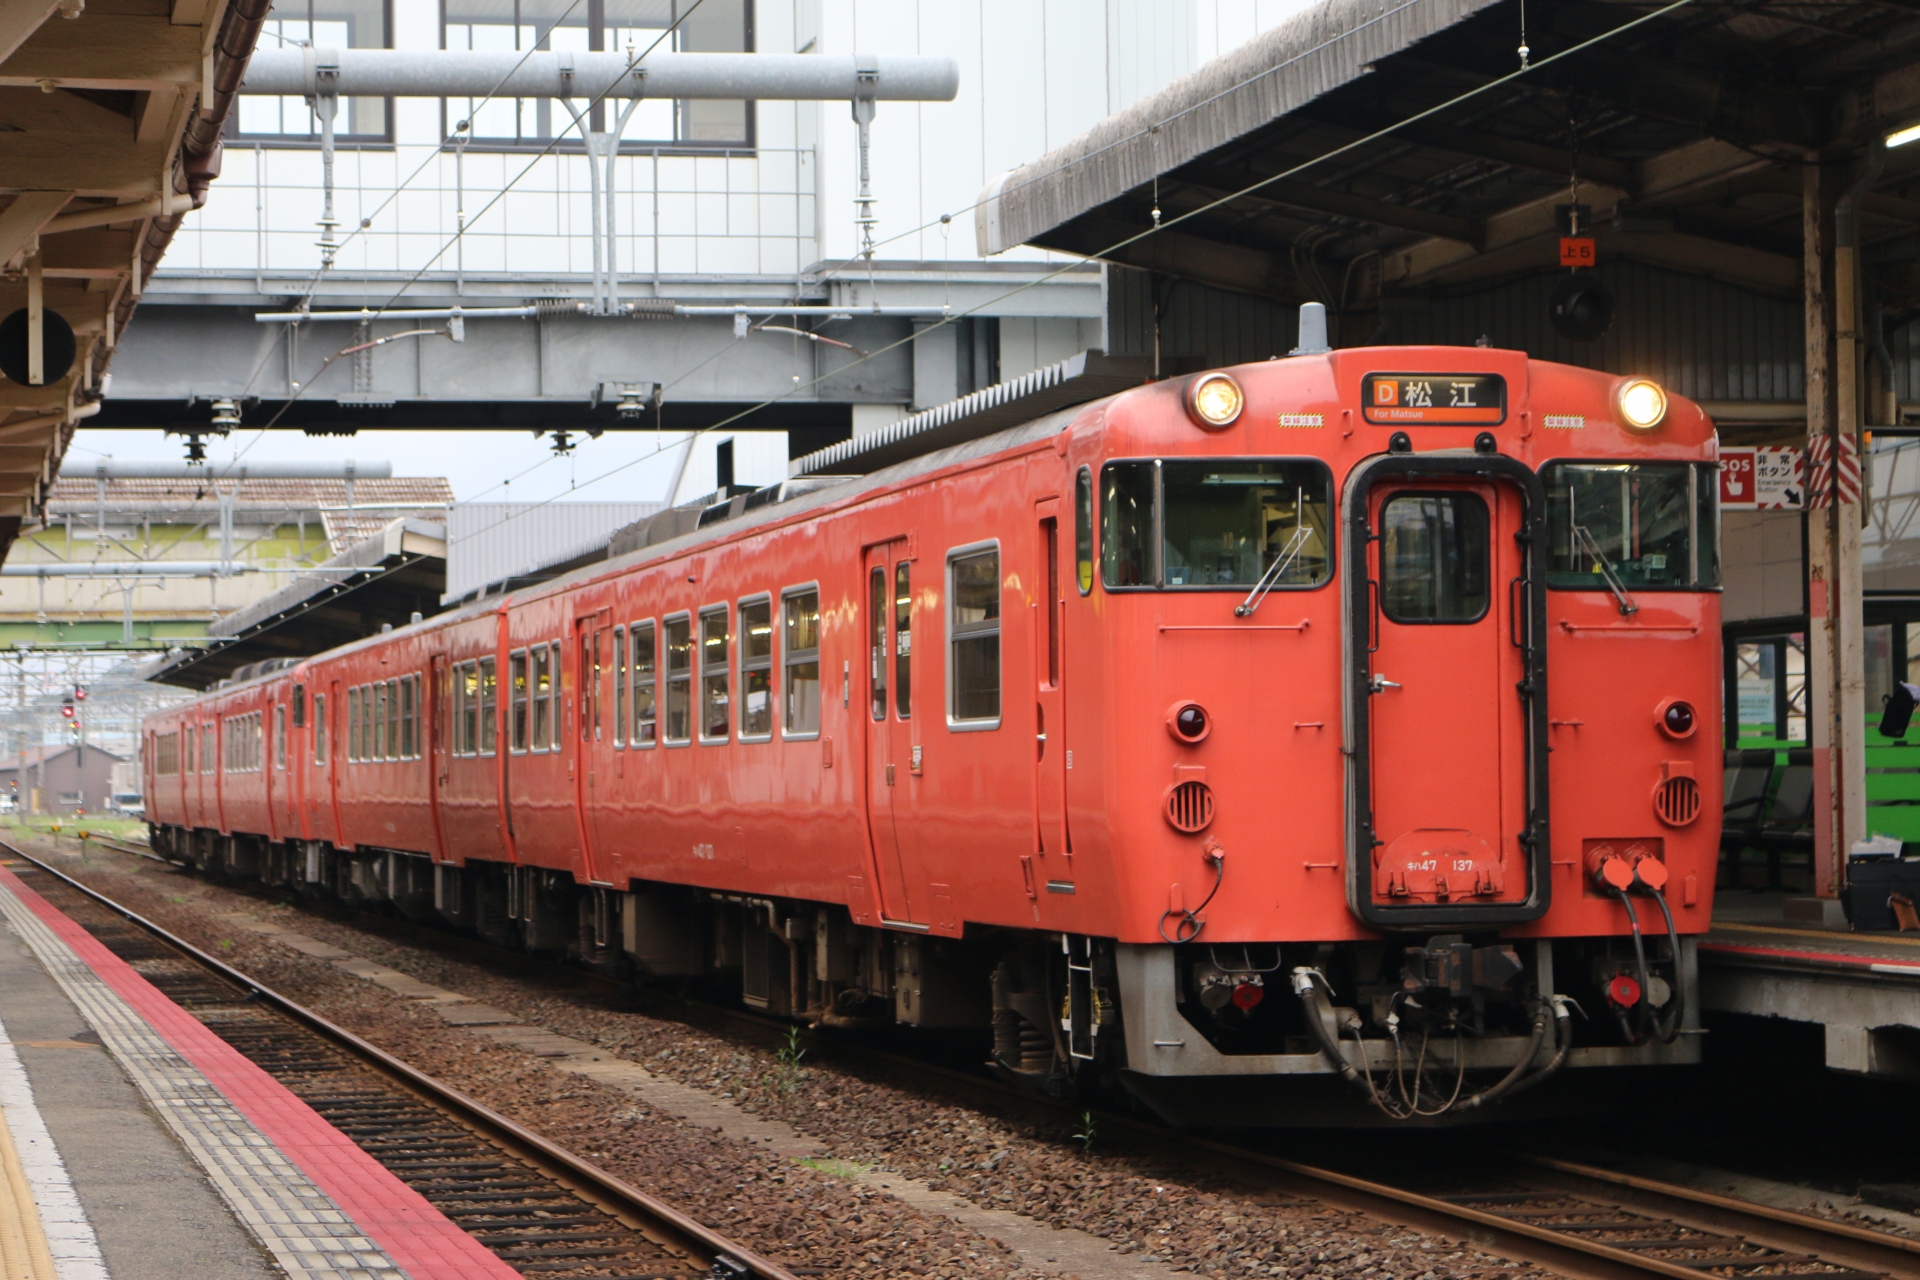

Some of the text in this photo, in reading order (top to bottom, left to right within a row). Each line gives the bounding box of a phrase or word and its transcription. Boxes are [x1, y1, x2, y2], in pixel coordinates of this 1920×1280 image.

[1378, 381, 1477, 408] D 松江
[1374, 410, 1423, 418] For Matsue
[1757, 454, 1791, 465] 非常
[1720, 459, 1750, 472] SOS
[1757, 466, 1791, 477] ボタン
[1757, 479, 1791, 487] Emergency
[1407, 860, 1473, 871] キハ47 137
